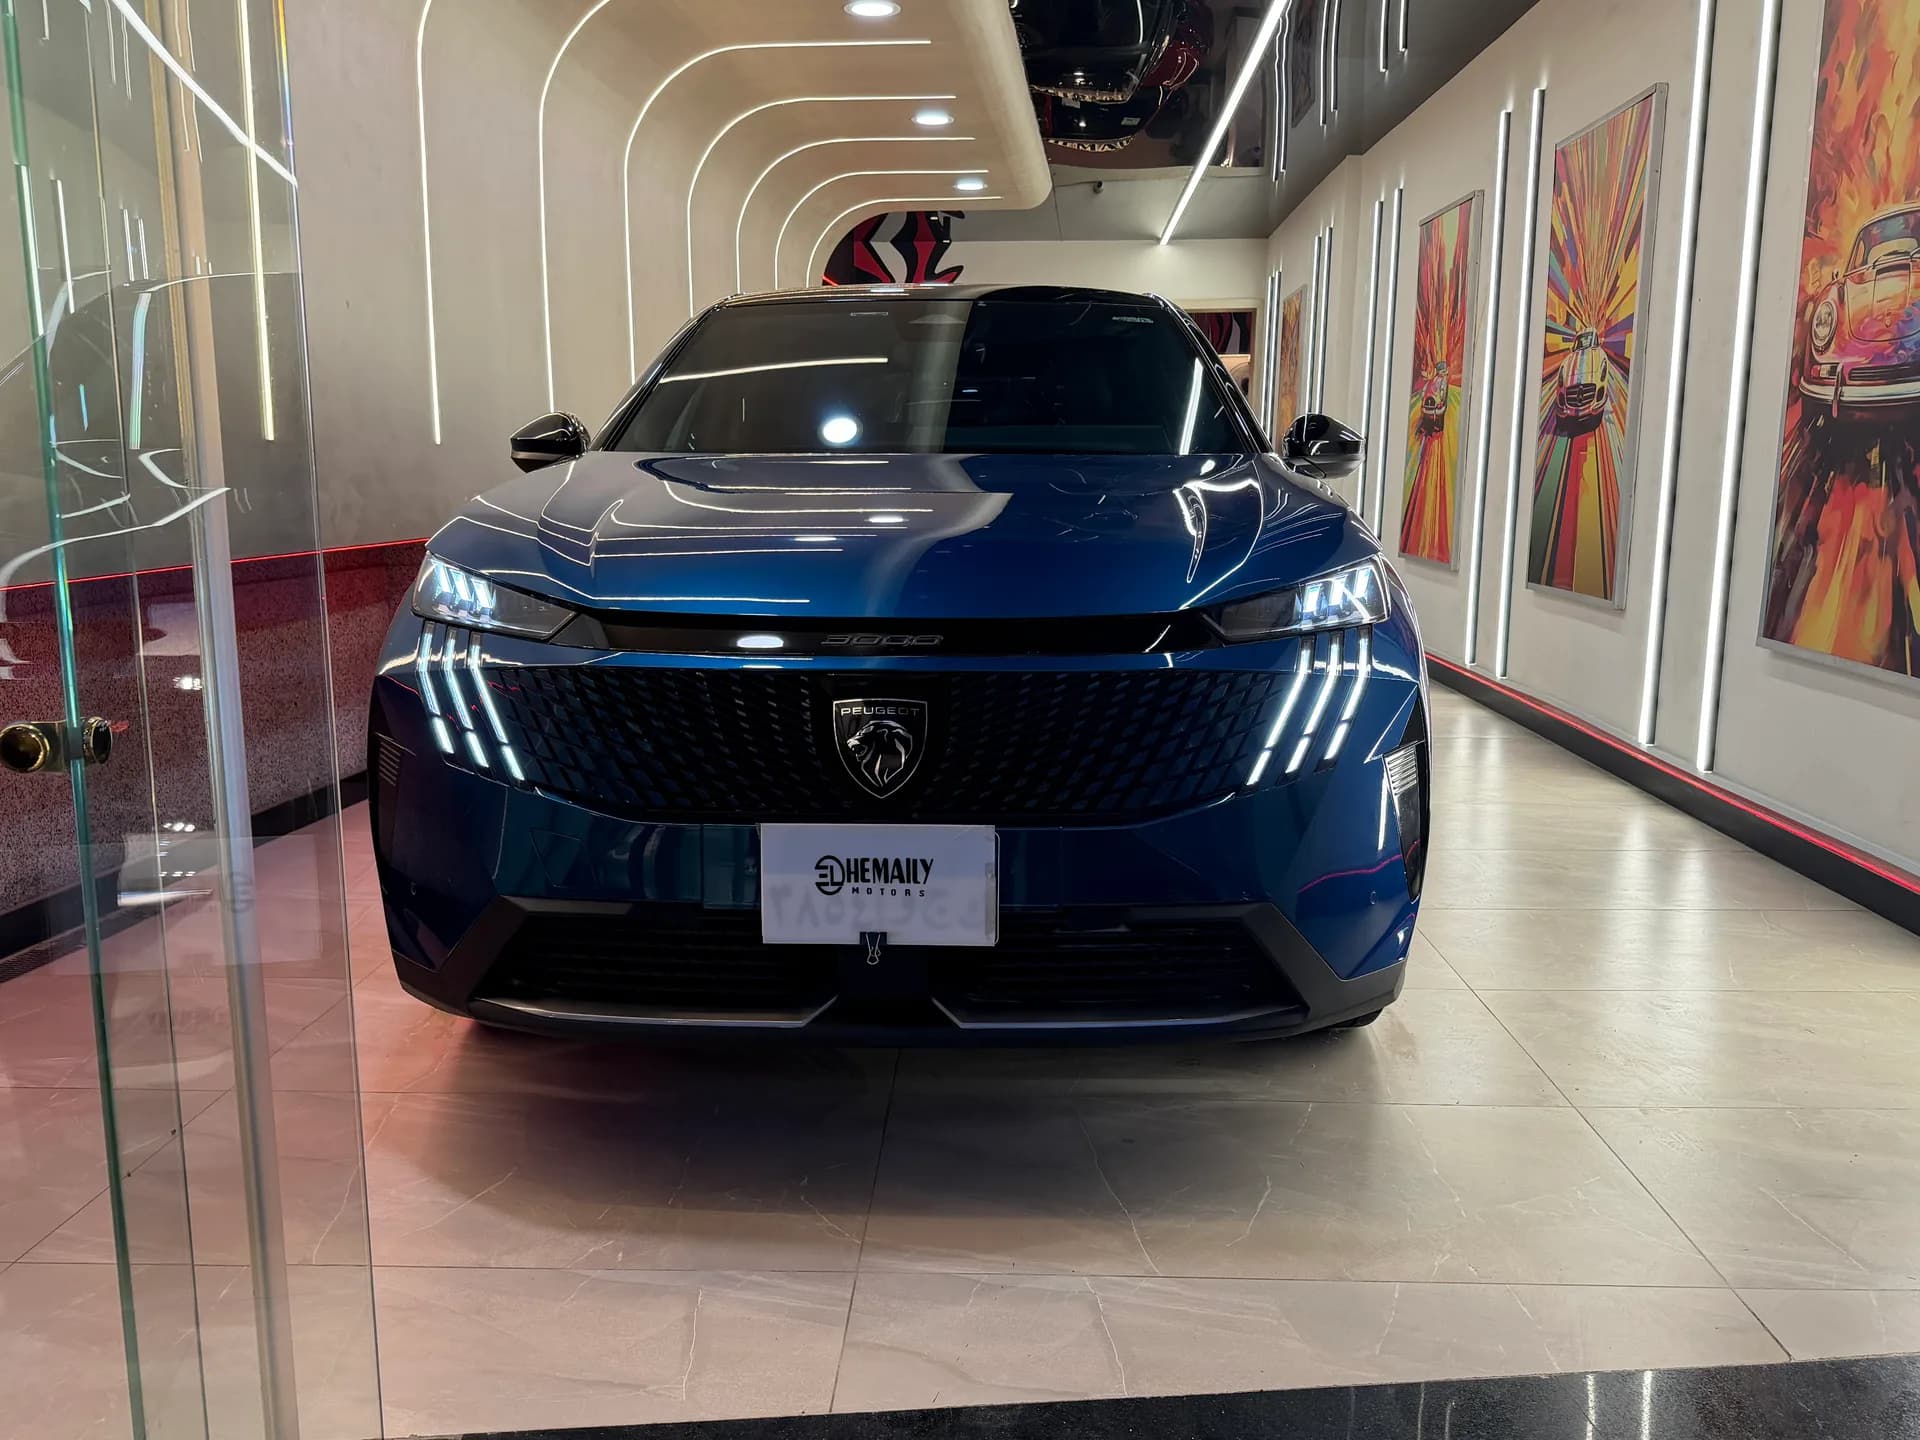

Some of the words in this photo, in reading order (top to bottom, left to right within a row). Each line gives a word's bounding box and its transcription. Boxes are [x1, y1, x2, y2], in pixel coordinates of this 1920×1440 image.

[820, 634, 944, 646] 3008
[840, 706, 920, 716] PEUGEOT
[852, 887, 925, 897] MOTORS
